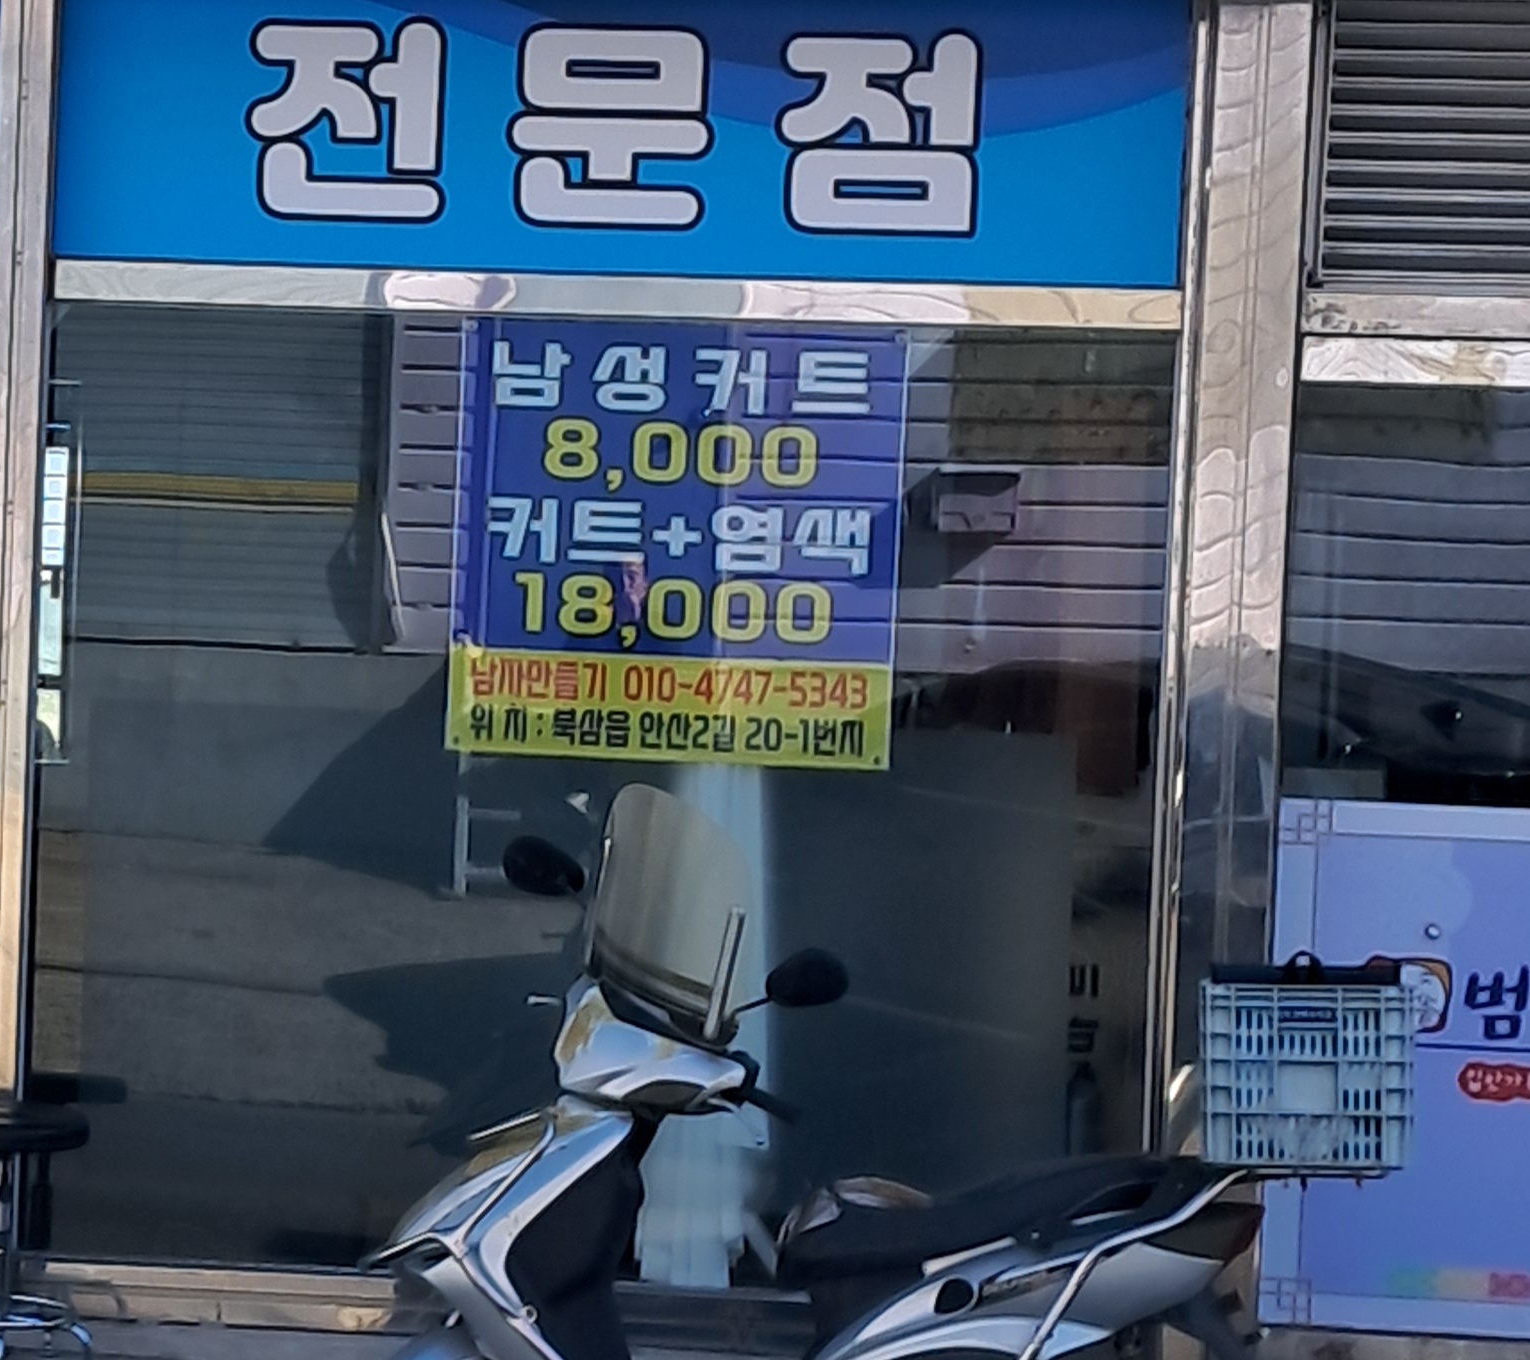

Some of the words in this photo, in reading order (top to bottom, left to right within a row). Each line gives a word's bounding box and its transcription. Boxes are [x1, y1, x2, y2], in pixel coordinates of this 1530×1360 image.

[246, 15, 982, 240] 전문점
[542, 417, 819, 491] 8,000
[486, 496, 872, 576] 커트+염색
[514, 571, 833, 648] 18,000
[470, 657, 607, 702] 남자만들기
[624, 664, 869, 710] 010-4747-5343
[744, 716, 866, 758] 20-1번지
